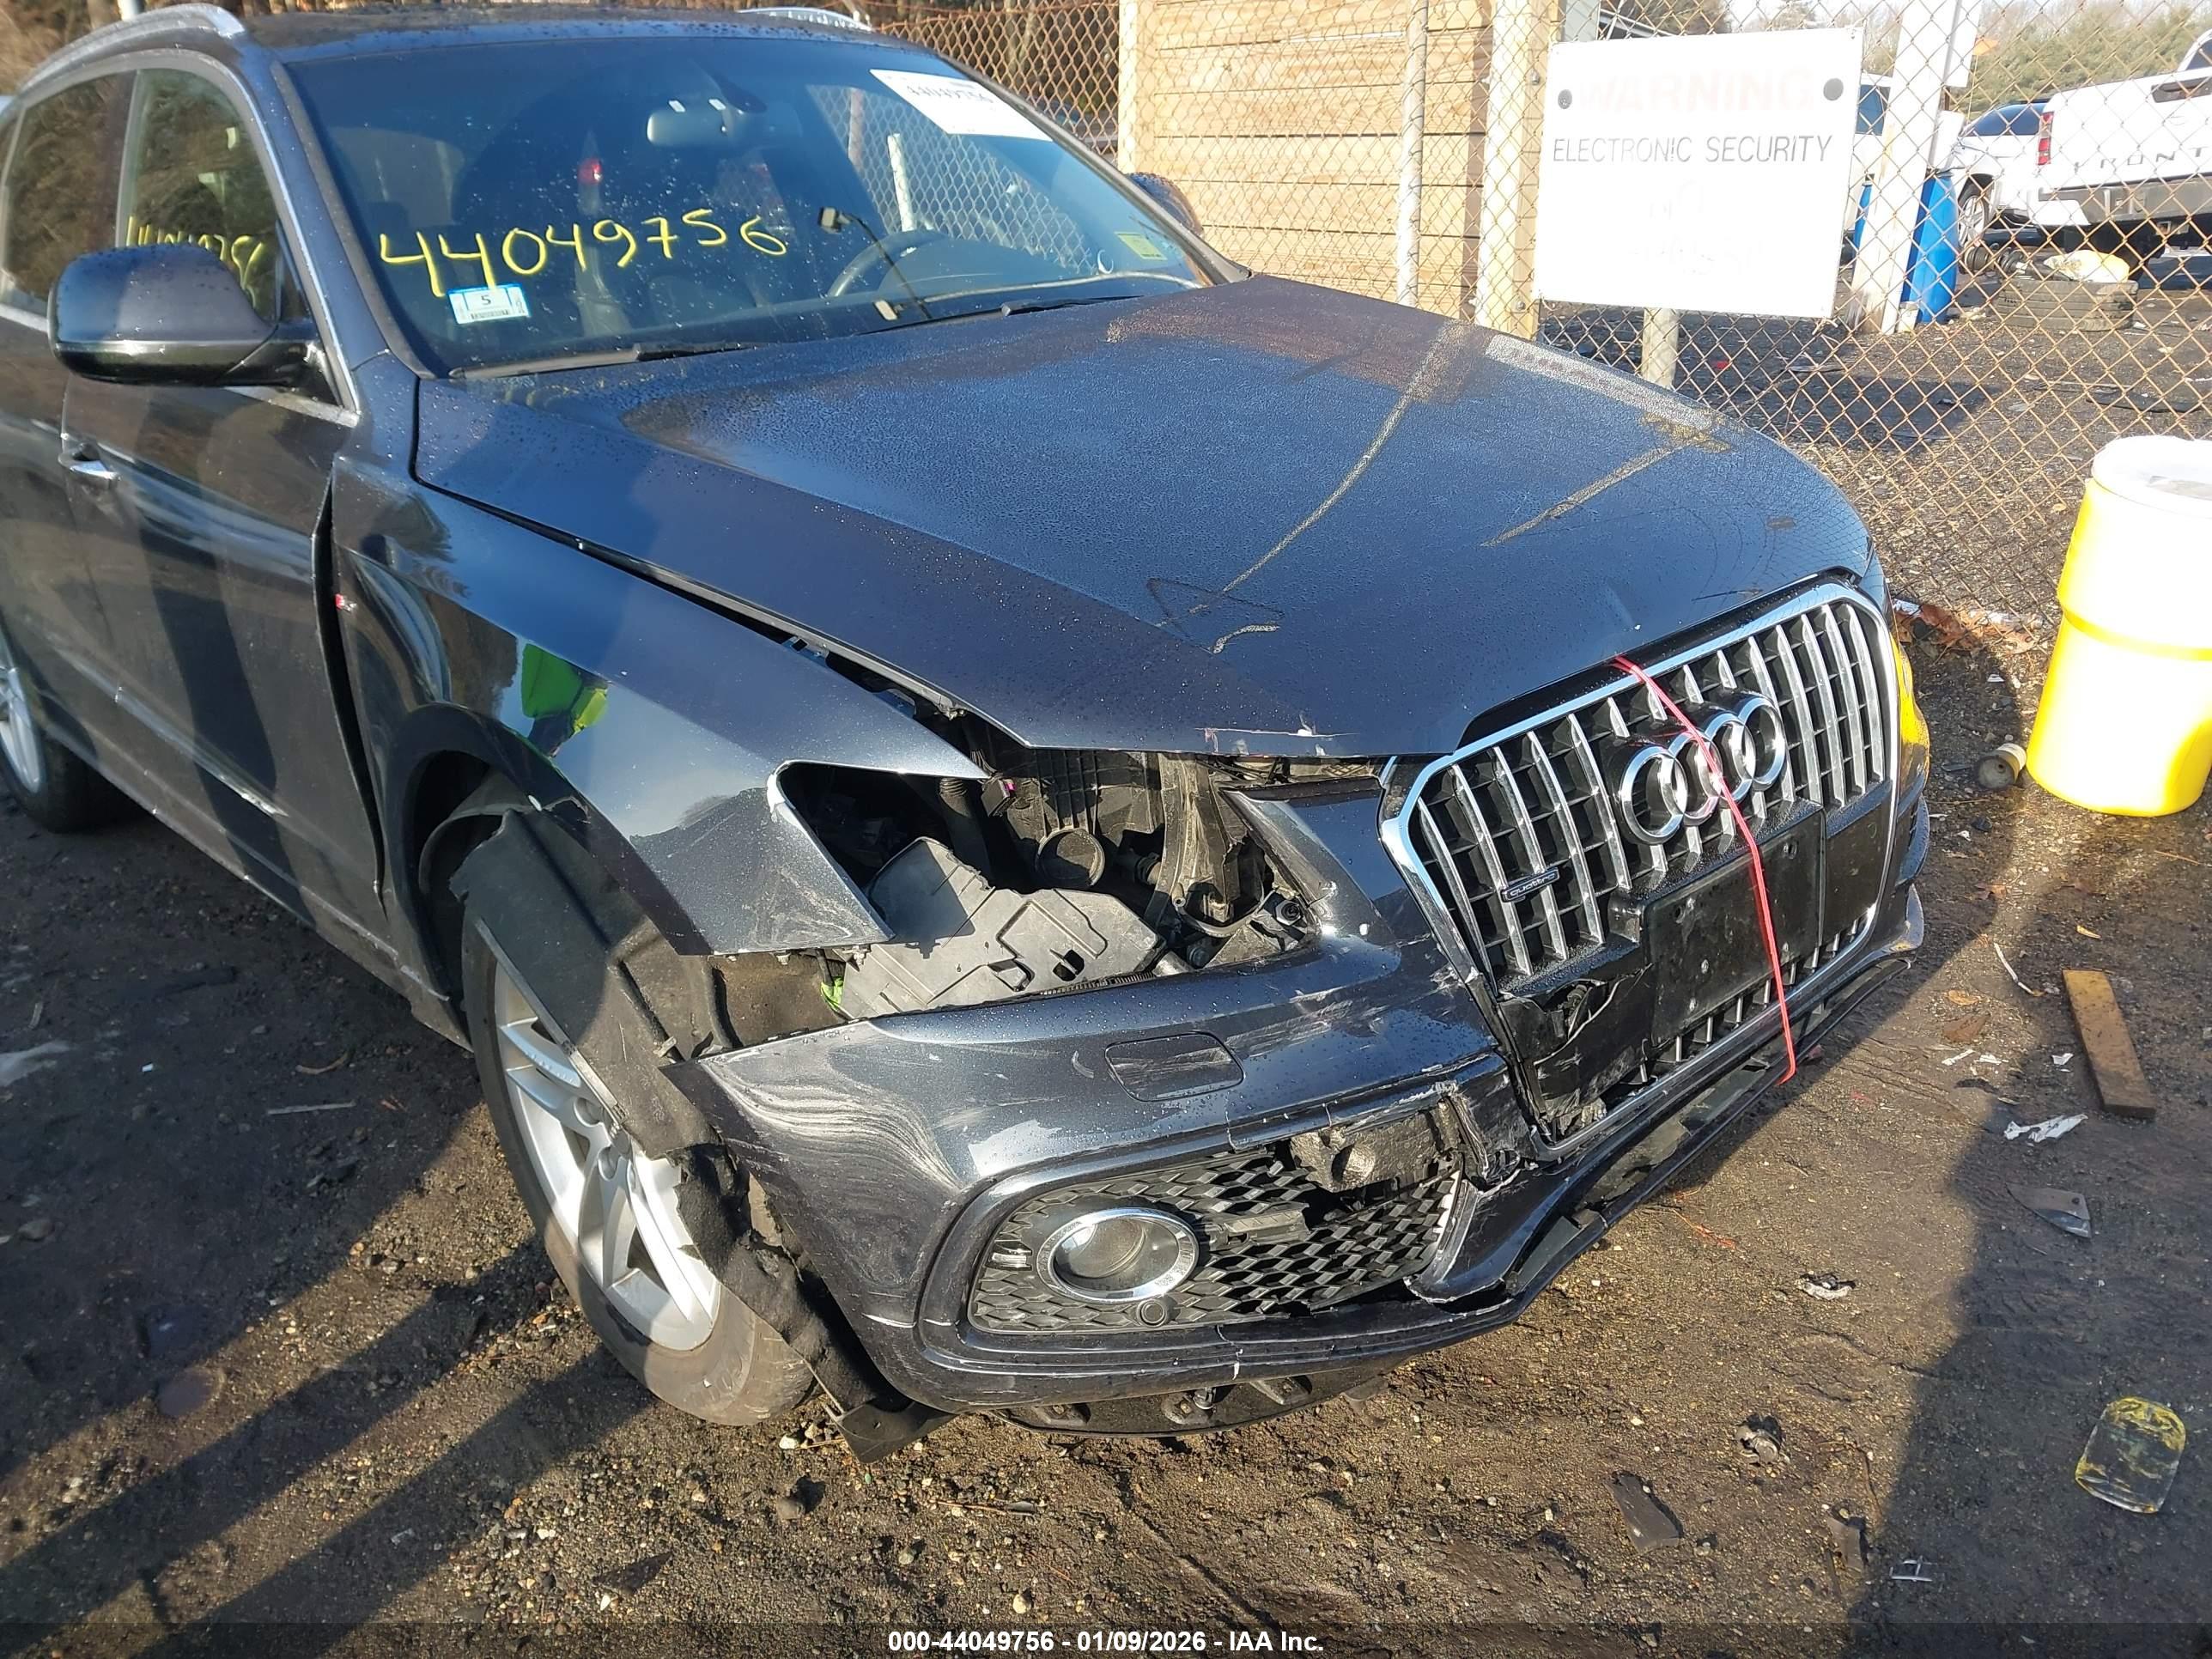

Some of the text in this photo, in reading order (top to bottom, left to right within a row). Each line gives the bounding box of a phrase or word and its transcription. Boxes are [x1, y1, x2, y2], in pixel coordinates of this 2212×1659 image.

[1580, 66, 1814, 112] WARNING
[1553, 135, 1833, 162] ELECTRONIC SECURITY
[380, 209, 787, 297] 44049756
[481, 295, 491, 305] 5
[1510, 873, 1555, 896] quattro
